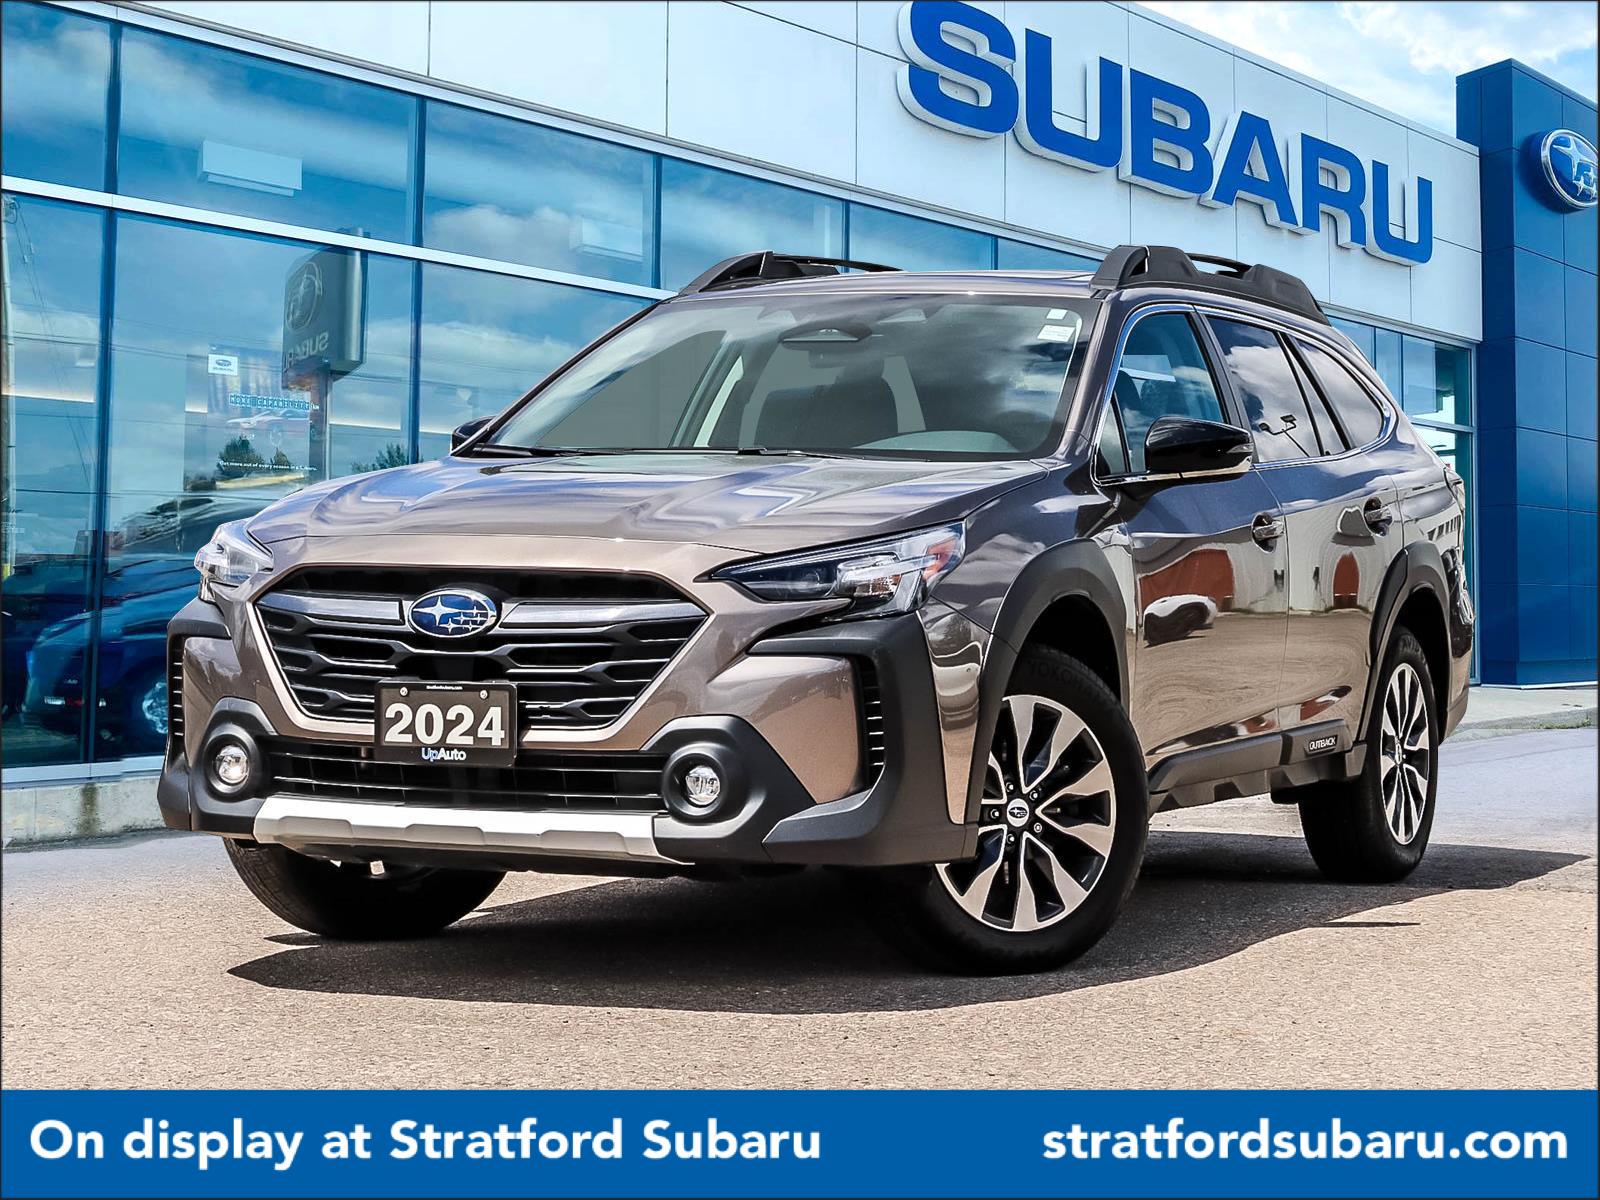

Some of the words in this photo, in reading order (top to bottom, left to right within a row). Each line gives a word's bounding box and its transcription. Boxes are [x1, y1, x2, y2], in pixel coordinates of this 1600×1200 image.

[899, 0, 1434, 265] SUBARU
[384, 702, 505, 746] 2024
[421, 747, 467, 762] UpAuto
[1309, 736, 1336, 750] OUTBACK
